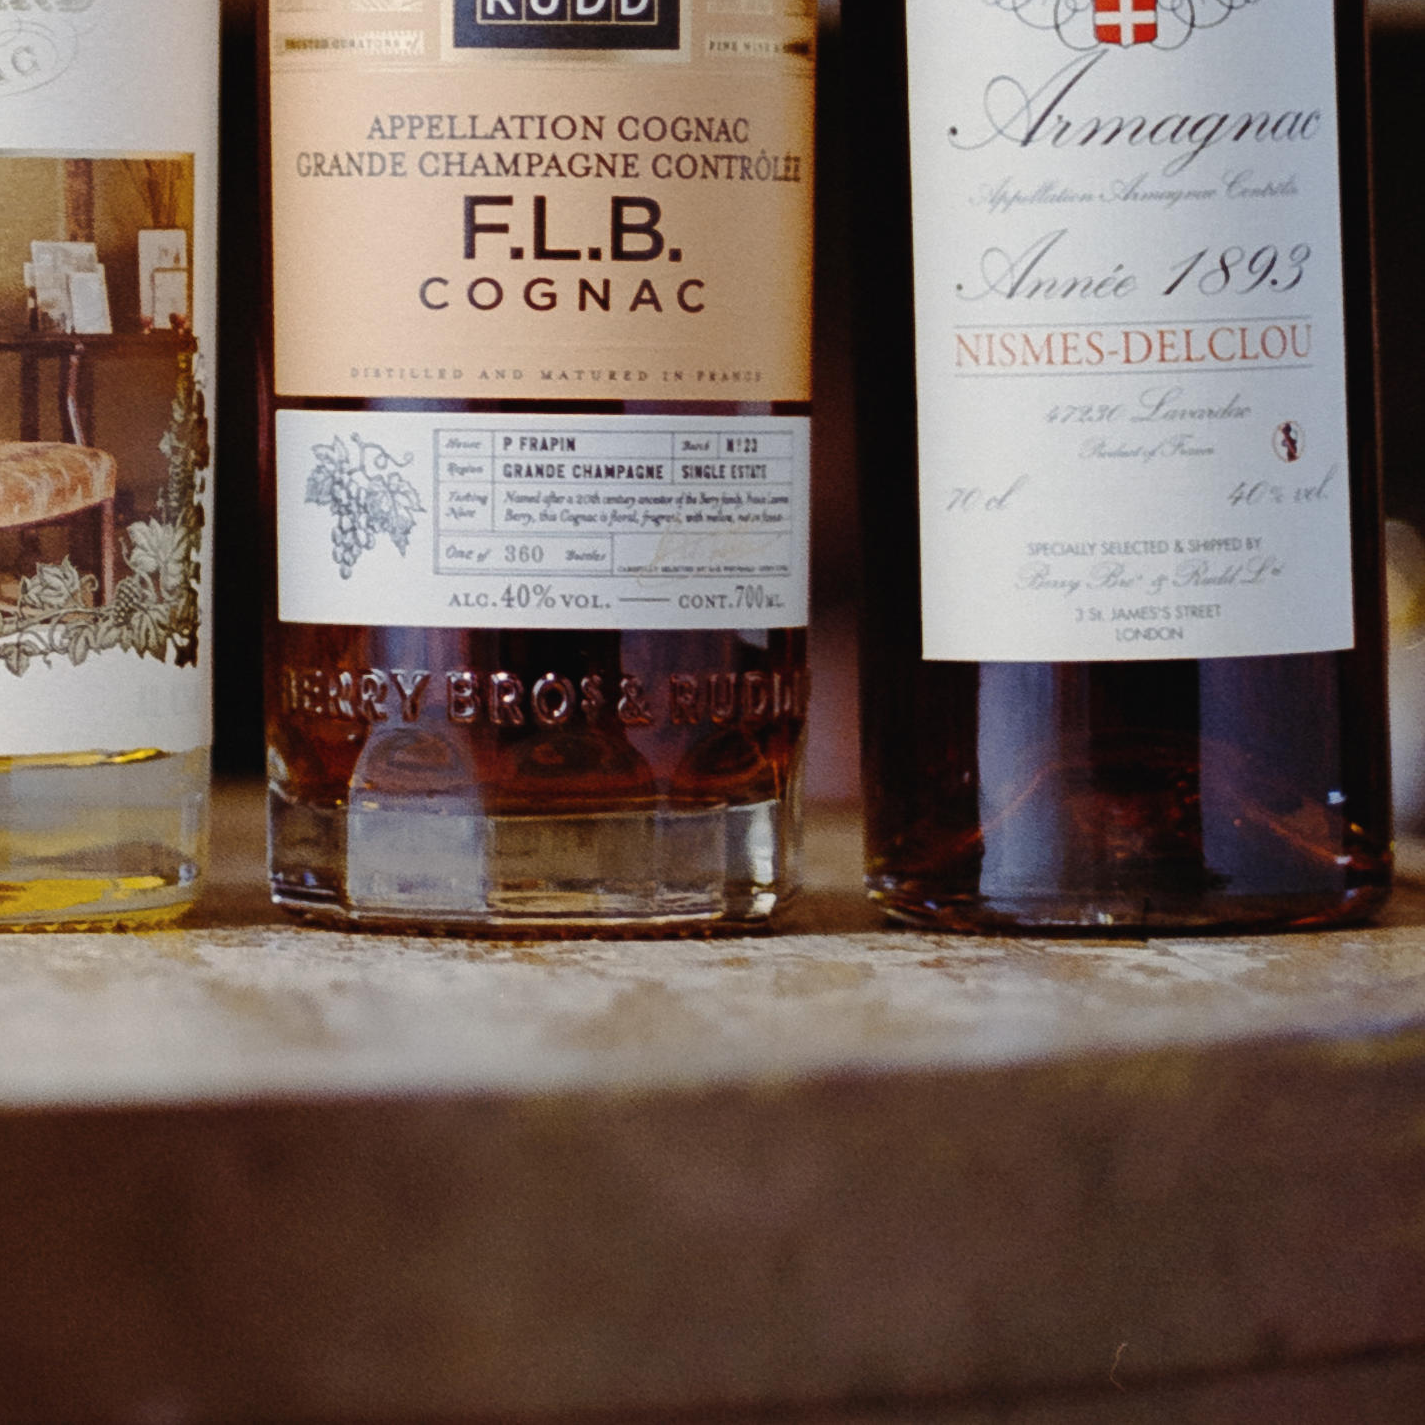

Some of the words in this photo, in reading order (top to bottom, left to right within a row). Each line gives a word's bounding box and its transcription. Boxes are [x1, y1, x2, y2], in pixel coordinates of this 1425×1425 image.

[947, 48, 1321, 178] Armagnac
[366, 113, 605, 141] APPELLATION
[616, 115, 749, 144] COGNAC
[296, 150, 408, 178] GRANDE
[418, 151, 641, 180] CHAMPAGNE
[650, 148, 802, 183] CONTRÔLÉE
[462, 195, 684, 263] F.L.B.
[954, 227, 1138, 302] Année
[1161, 242, 1313, 298] 1893
[418, 276, 705, 314] COGNAC
[953, 323, 1314, 369] NISMES-DELCLOU
[349, 366, 464, 381] DISTILLED
[478, 367, 524, 382] AND
[539, 368, 649, 383] MATURED
[661, 370, 684, 384] IN
[503, 436, 513, 451] P
[519, 436, 577, 452] FRAPIN
[502, 462, 566, 479] GRANDE
[571, 463, 664, 480] CHAMPAGNE
[680, 463, 726, 480] SINGLE
[730, 463, 767, 480] ESTATE
[503, 544, 545, 564] 360
[1026, 541, 1097, 559] SPECIALLY
[1099, 539, 1171, 557] SELECTED
[1173, 539, 1185, 556] &
[1245, 536, 1263, 552] BY
[560, 592, 611, 610] VOL.
[1110, 605, 1173, 623] JAMES'S
[1174, 603, 1223, 621] STREET
[1114, 625, 1184, 644] LONDON
[445, 670, 606, 727] BROS
